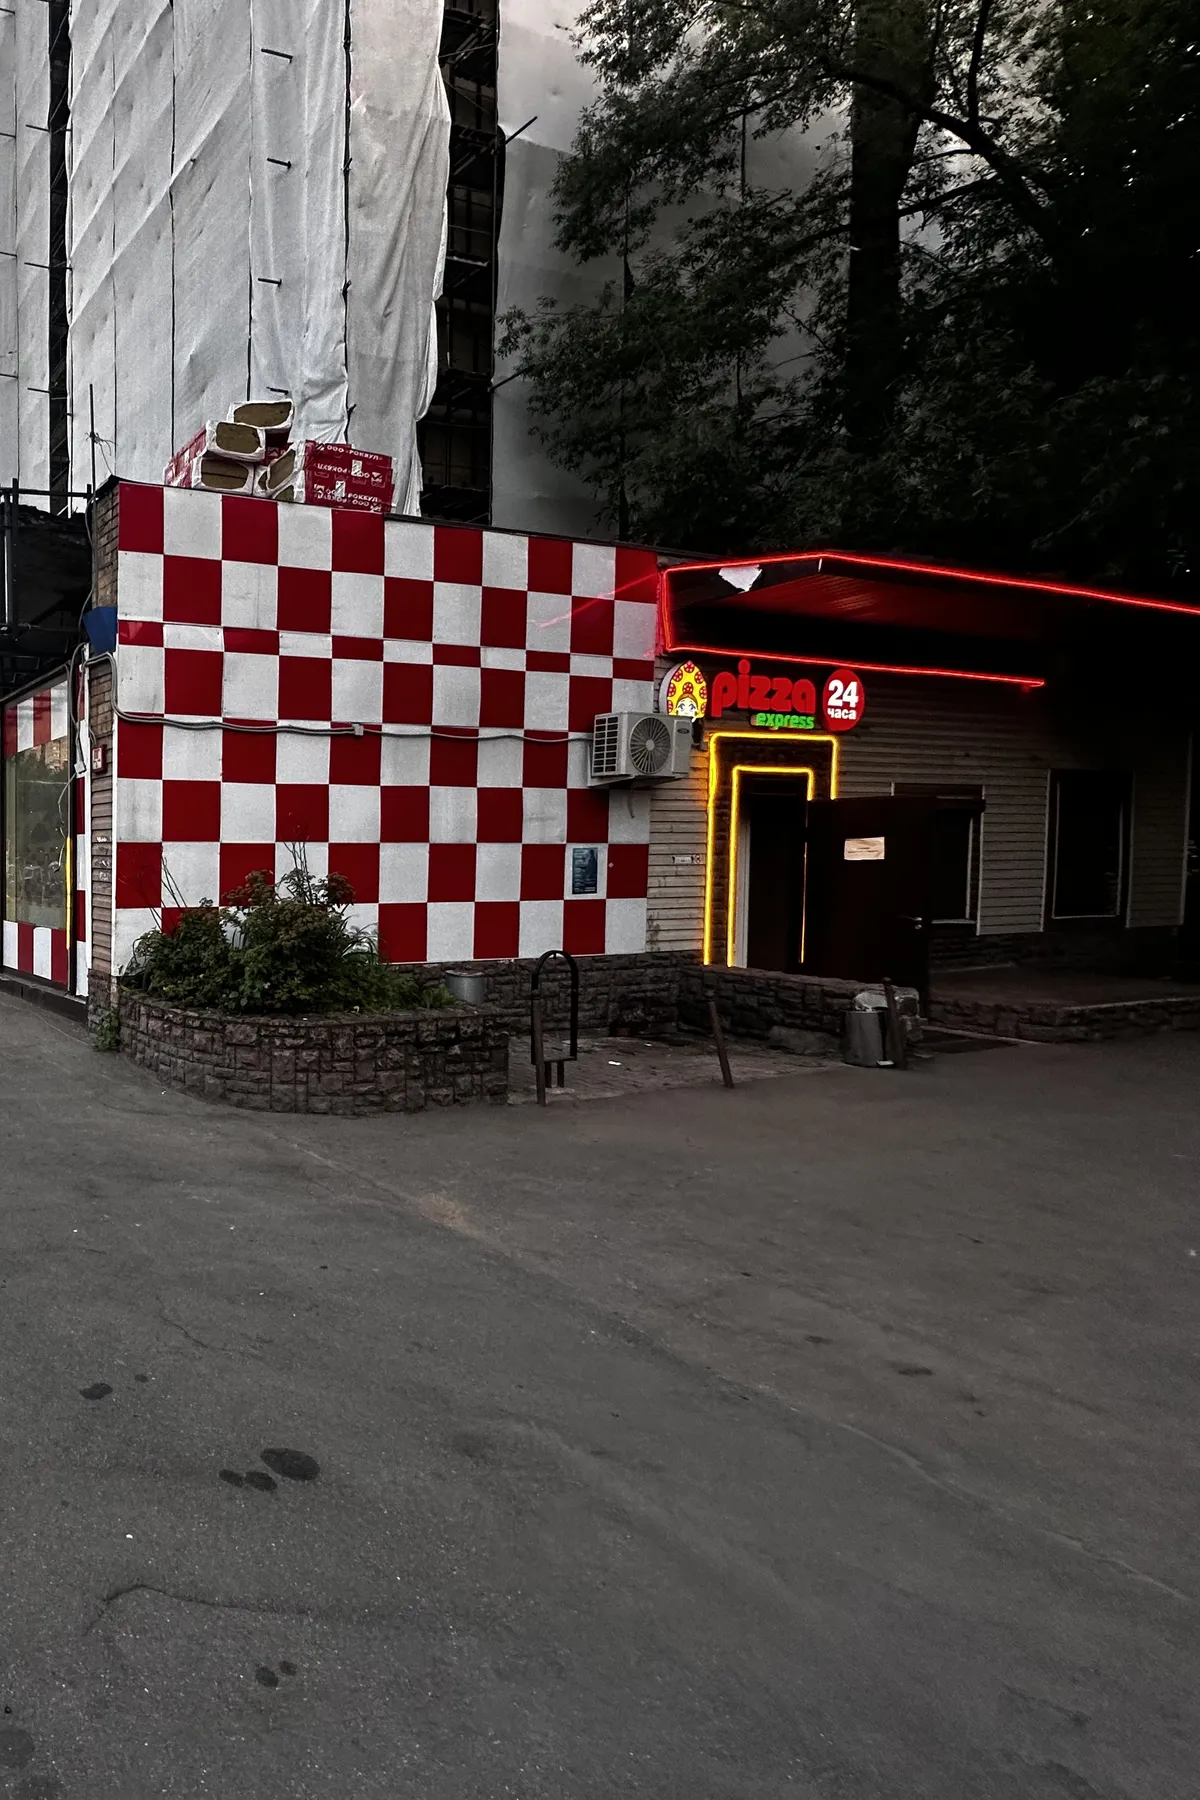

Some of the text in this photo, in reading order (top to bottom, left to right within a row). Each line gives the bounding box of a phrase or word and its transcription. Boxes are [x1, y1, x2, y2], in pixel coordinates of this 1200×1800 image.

[711, 659, 816, 717] pizza
[828, 680, 859, 708] 24
[756, 713, 815, 729] express
[827, 708, 857, 720] часа
